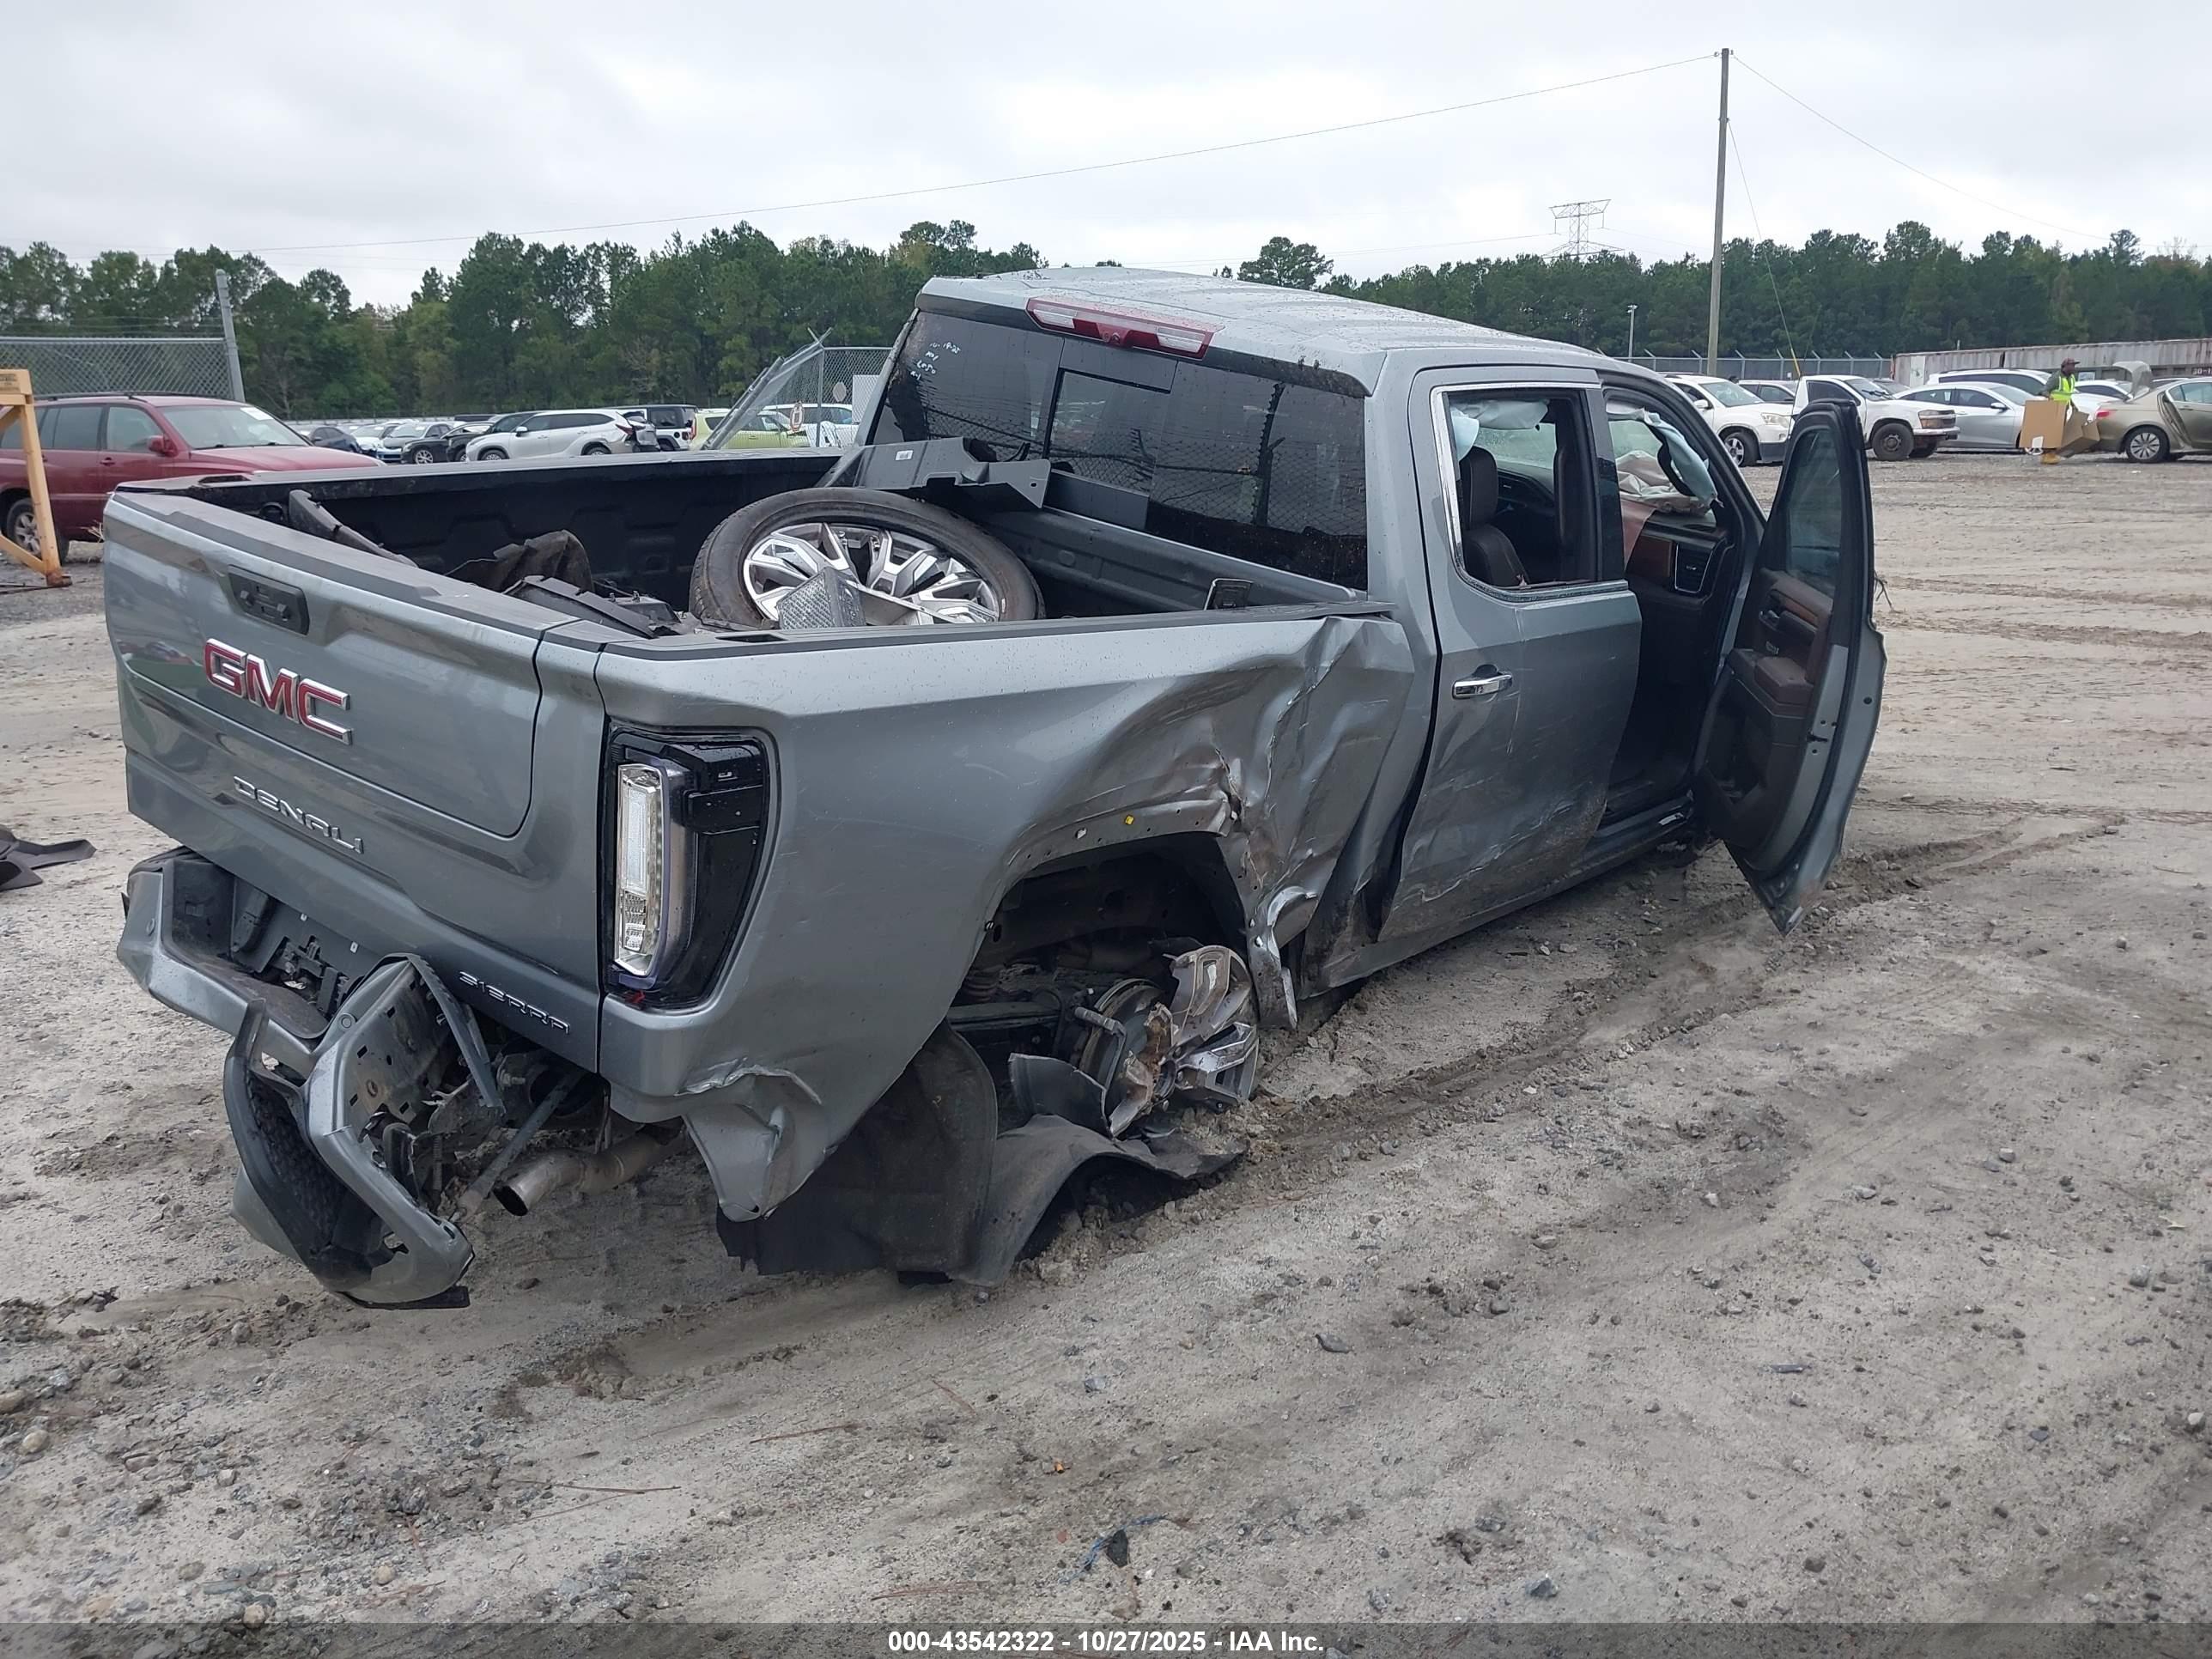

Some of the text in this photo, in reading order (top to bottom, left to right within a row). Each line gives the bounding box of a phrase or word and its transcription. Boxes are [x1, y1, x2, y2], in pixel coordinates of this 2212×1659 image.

[204, 638, 353, 745] GMC
[234, 775, 364, 854] DENALI
[459, 971, 570, 1034] SIERRA
